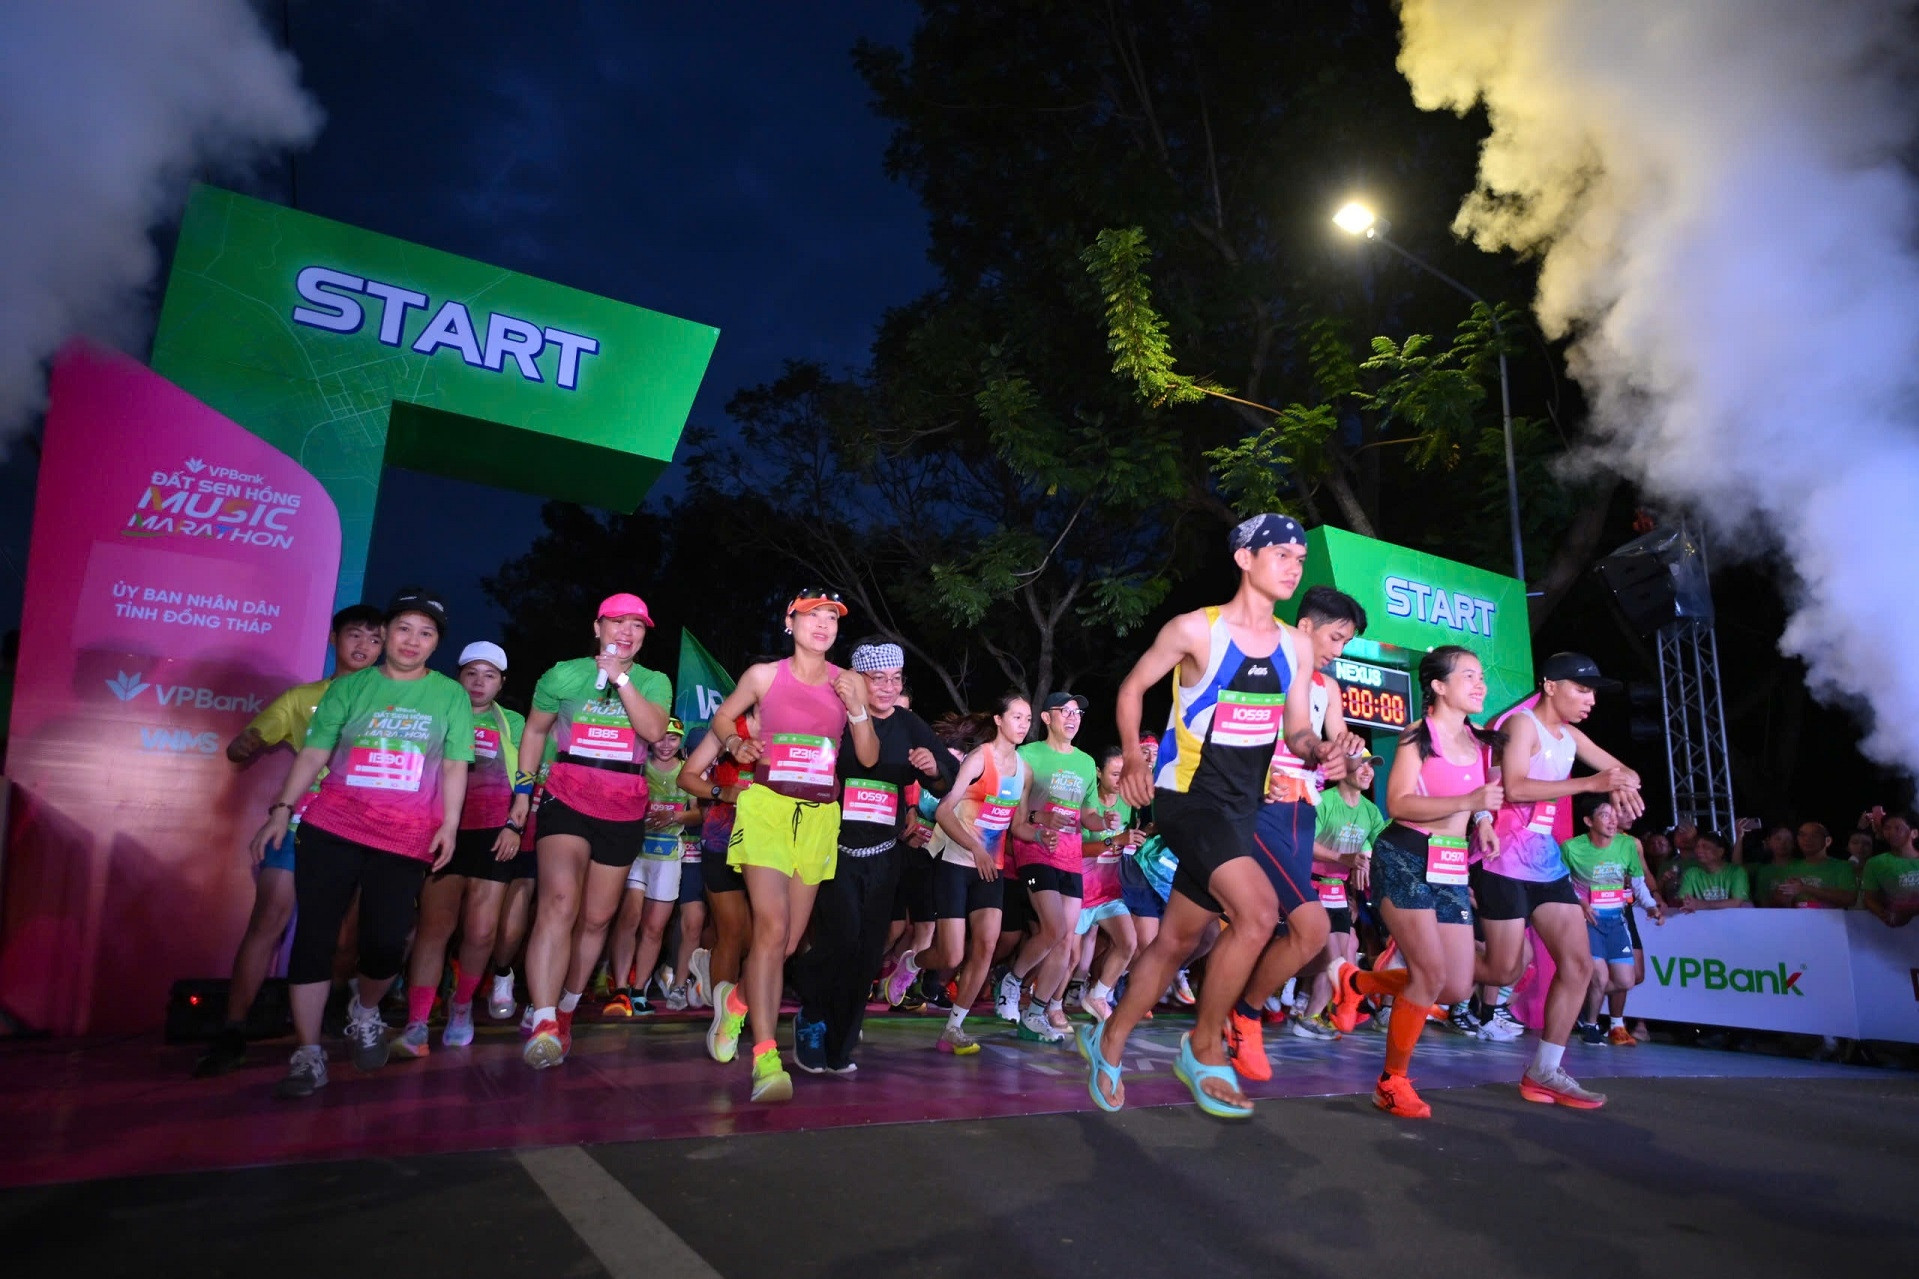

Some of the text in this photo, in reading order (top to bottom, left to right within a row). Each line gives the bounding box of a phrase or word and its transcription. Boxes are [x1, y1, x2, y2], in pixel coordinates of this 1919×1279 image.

[293, 265, 599, 390] START
[152, 470, 301, 507] ĐẤT SEN HỒNG
[209, 465, 265, 484] VPBank
[138, 486, 297, 531] MUSIC
[128, 513, 294, 549] MARATHON
[115, 602, 272, 634] TỈNH ĐỒNG THÁP
[143, 588, 182, 603] BAN
[187, 594, 238, 612] NHÂN
[242, 601, 281, 617] DÂN
[1385, 576, 1495, 637] START
[1335, 661, 1382, 687] NEXUS
[156, 684, 265, 713] VPBank
[1232, 708, 1271, 721] 10593
[1342, 687, 1405, 724] :00:00
[369, 718, 432, 731] MUSIC
[857, 790, 888, 803] 10597
[1651, 956, 1805, 997] VPBank
